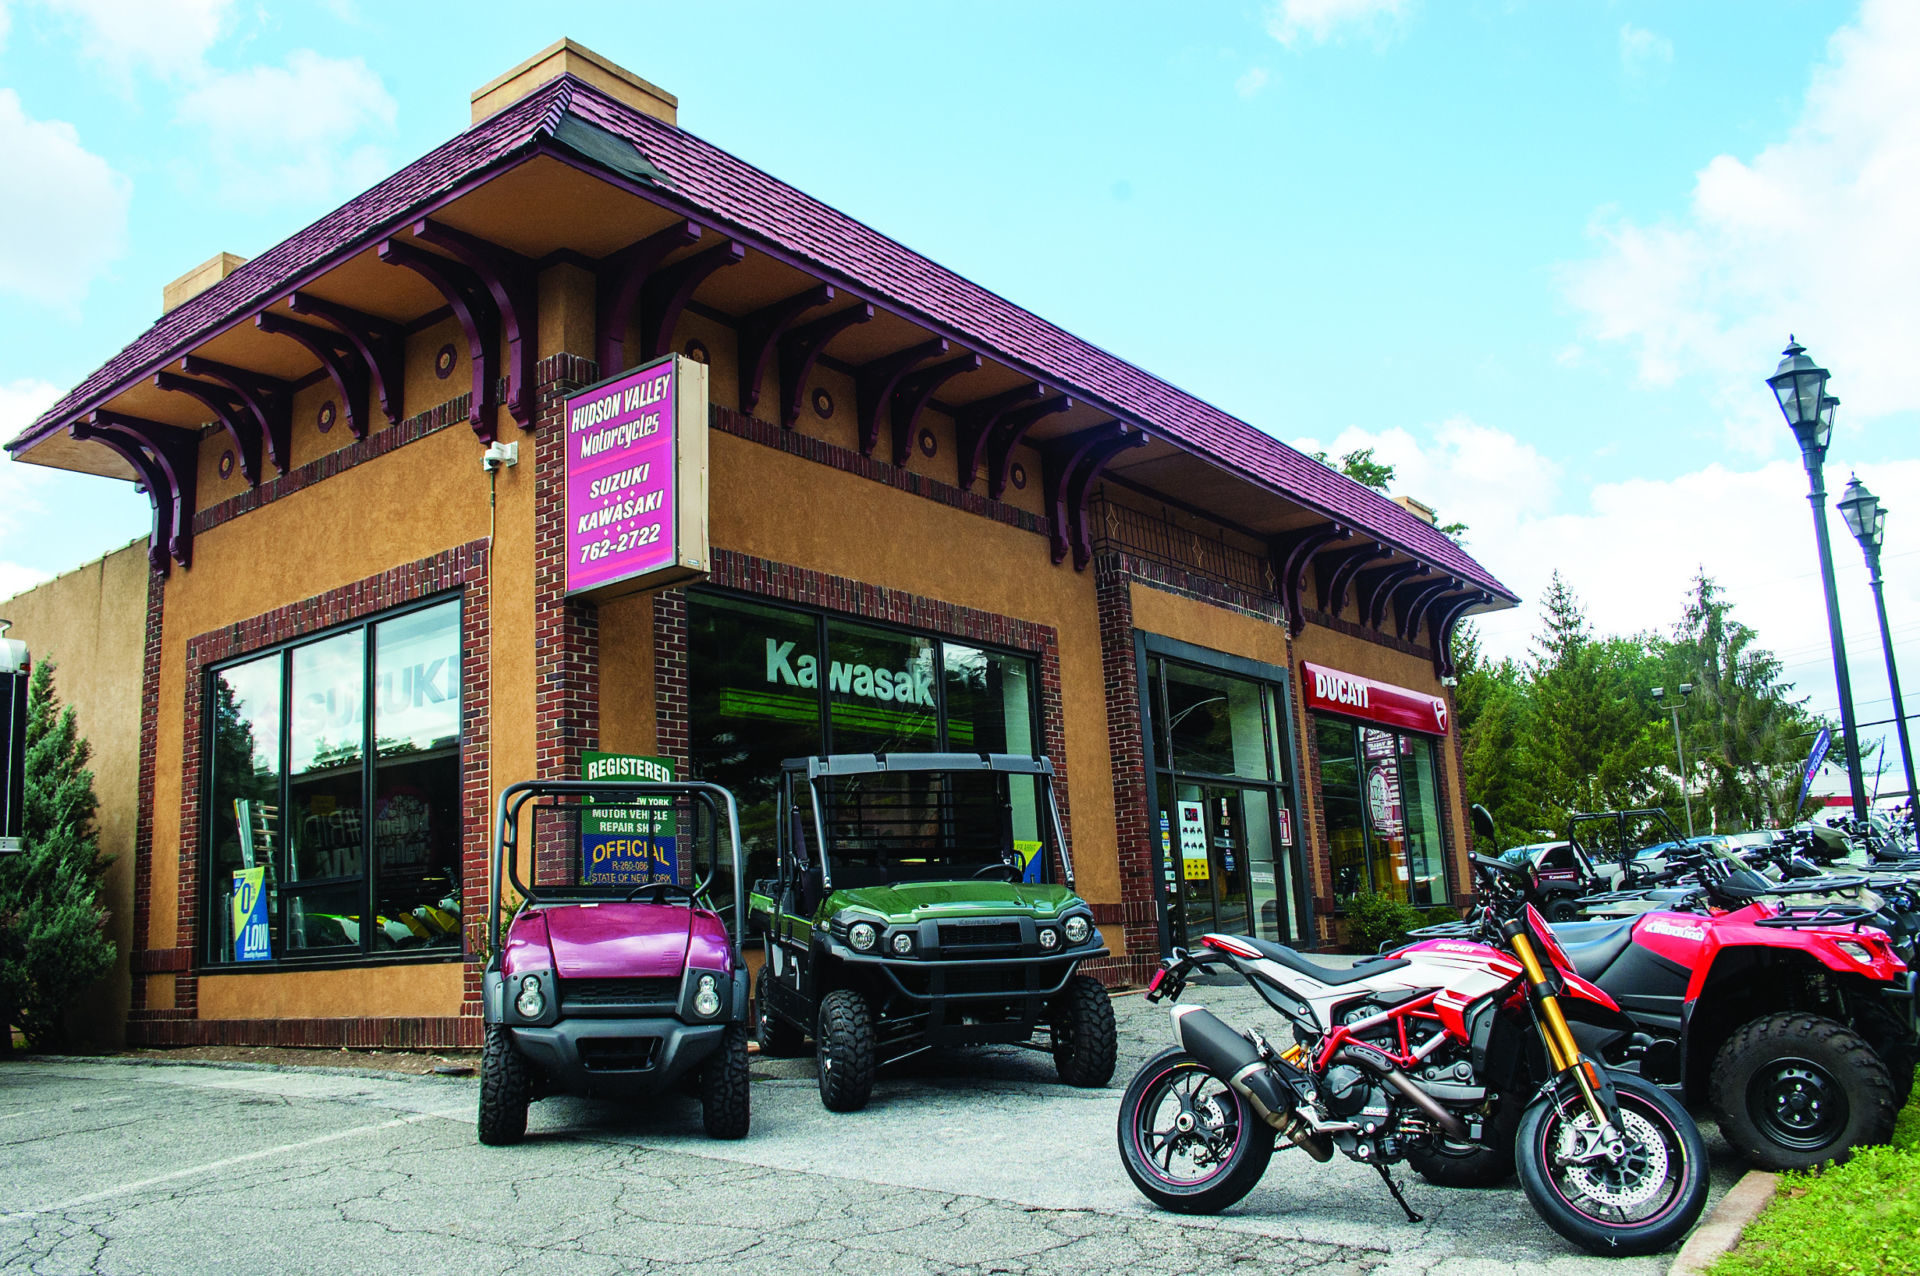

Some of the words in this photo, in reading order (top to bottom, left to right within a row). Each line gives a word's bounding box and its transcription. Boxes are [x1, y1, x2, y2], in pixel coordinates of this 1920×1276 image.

[571, 393, 622, 433] HUDSON
[624, 374, 671, 414] VALLEY
[580, 412, 660, 459] Motorcycles
[590, 463, 650, 499] SUZUKI
[577, 490, 664, 534] KAWASAKI
[580, 523, 661, 564] 762-2722
[766, 638, 937, 707] Kawasak
[1315, 672, 1368, 709] DUCATI
[588, 757, 670, 783] REGISTERED
[592, 809, 627, 819] MOTOR
[648, 797, 669, 806] YORK
[600, 821, 634, 832] REPAIR
[636, 823, 662, 833] SHP
[592, 873, 616, 882] STATE
[617, 873, 629, 882] OF
[630, 873, 649, 883] NEW
[653, 873, 672, 884] ORK
[244, 923, 268, 952] LOW
